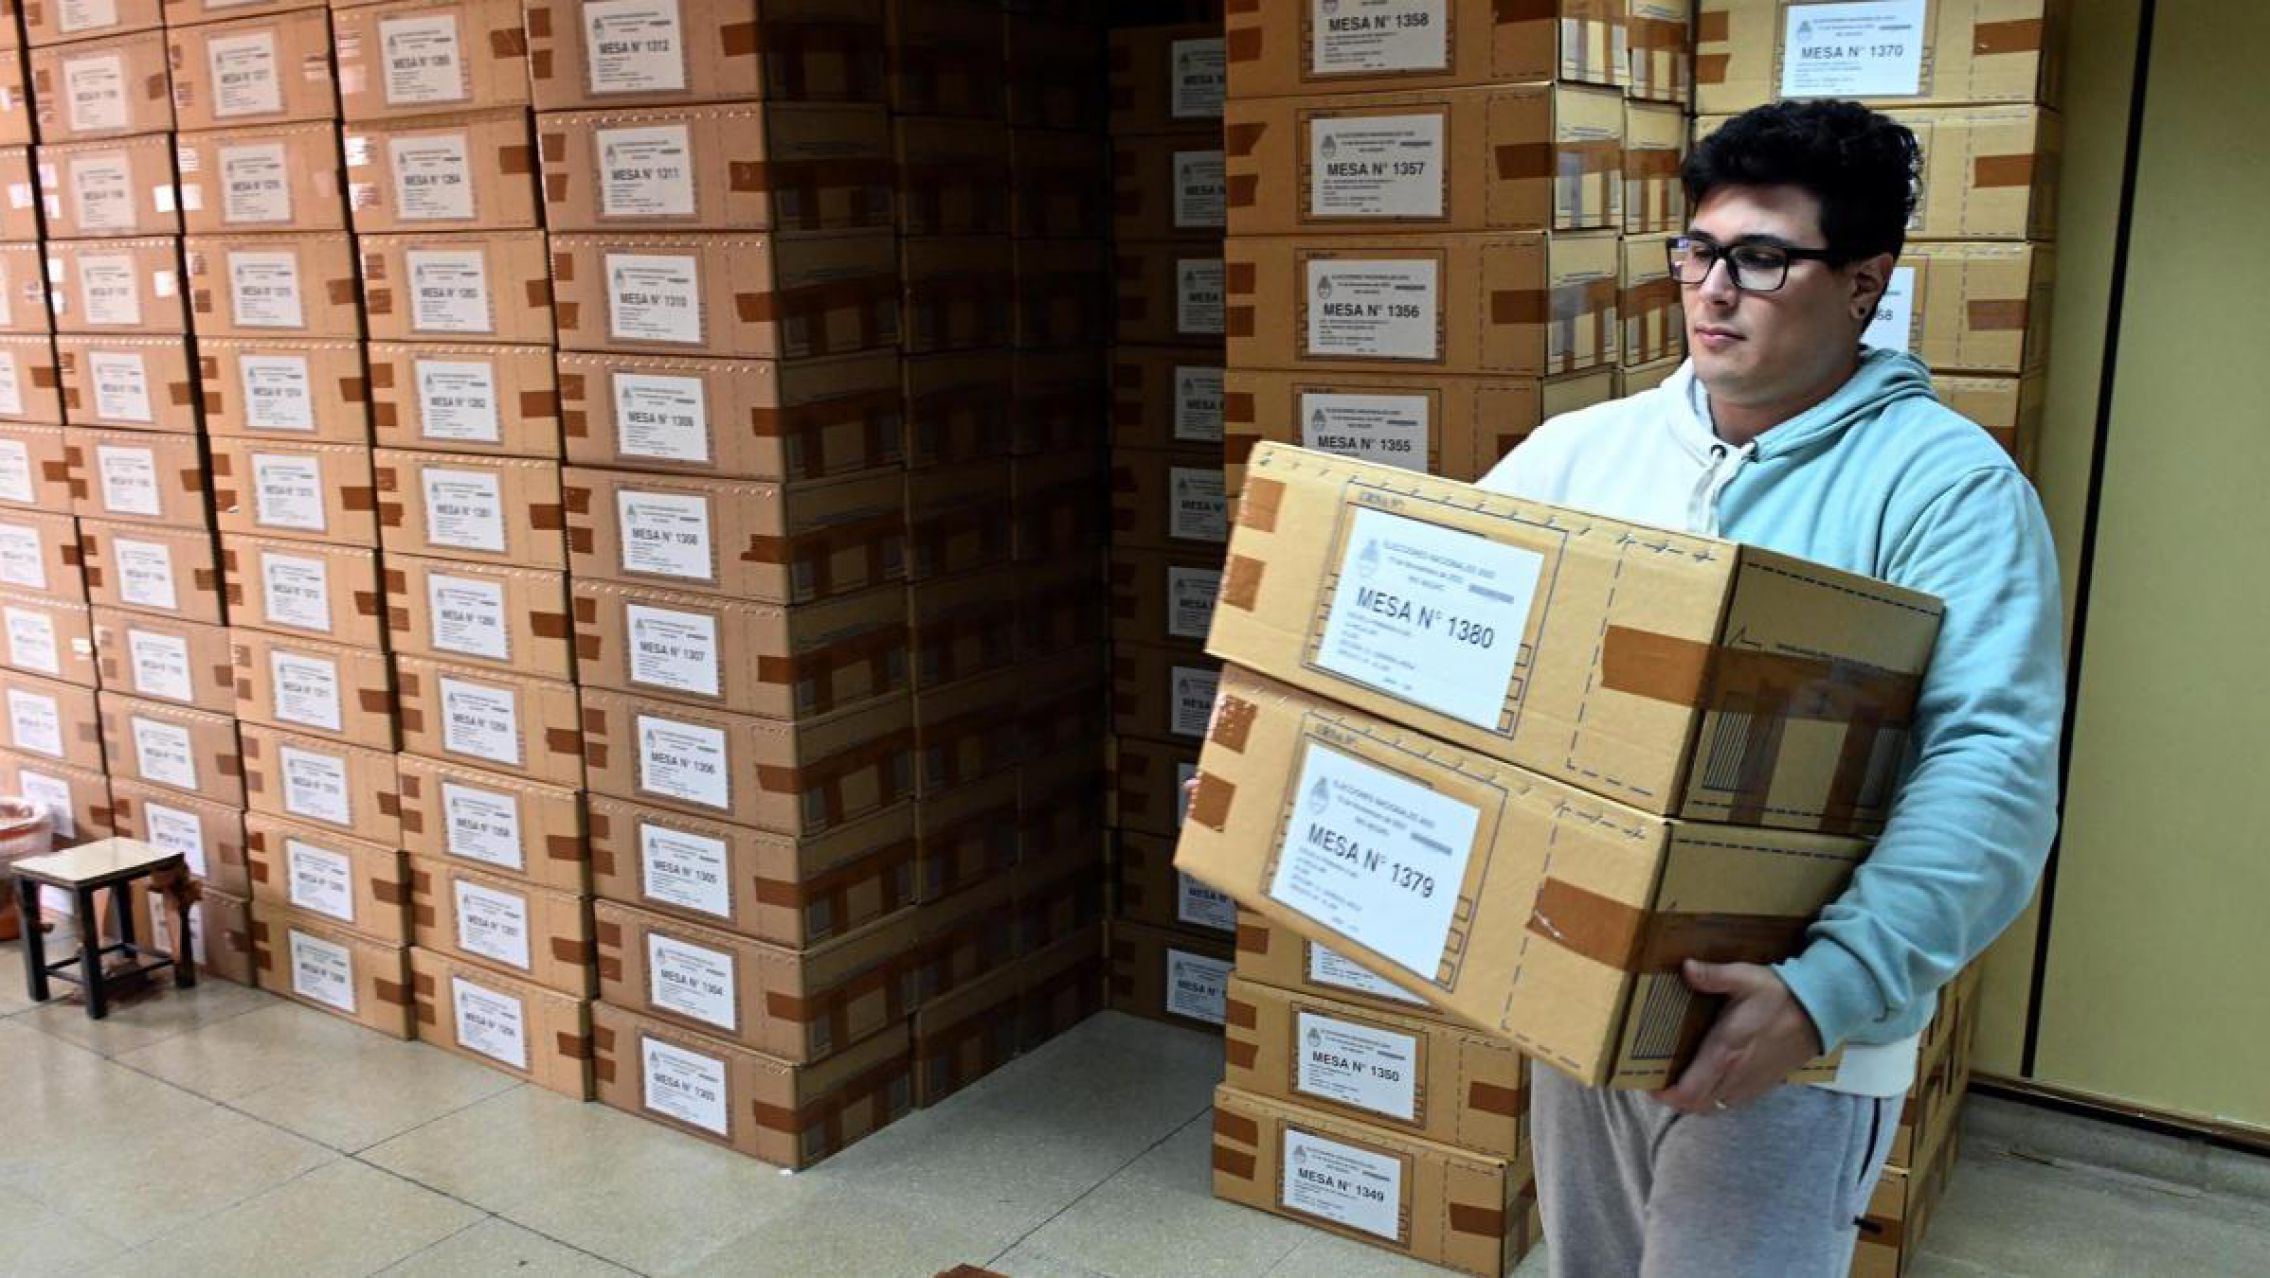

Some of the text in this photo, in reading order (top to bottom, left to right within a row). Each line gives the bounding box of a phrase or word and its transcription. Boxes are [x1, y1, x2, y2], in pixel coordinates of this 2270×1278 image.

[1329, 15, 1370, 31] MESA
[1395, 12, 1429, 28] 1358
[1802, 46, 1842, 60] MESA
[1870, 45, 1903, 58] 1370
[1327, 162, 1369, 177] MESA
[1392, 161, 1425, 176] 1357
[1324, 303, 1362, 317] MESA
[1387, 304, 1420, 318] 1356
[1318, 435, 1357, 449] MESA
[1380, 439, 1411, 453] 1355
[1356, 587, 1411, 623] MESA
[1448, 617, 1494, 649] 1380
[1308, 823, 1359, 864] MESA
[1392, 863, 1434, 898] 1379
[1312, 1050, 1349, 1070] MESA
[1370, 1066, 1399, 1082] 1350
[1298, 1167, 1334, 1188] MESA
[1356, 1184, 1384, 1202] 1349
